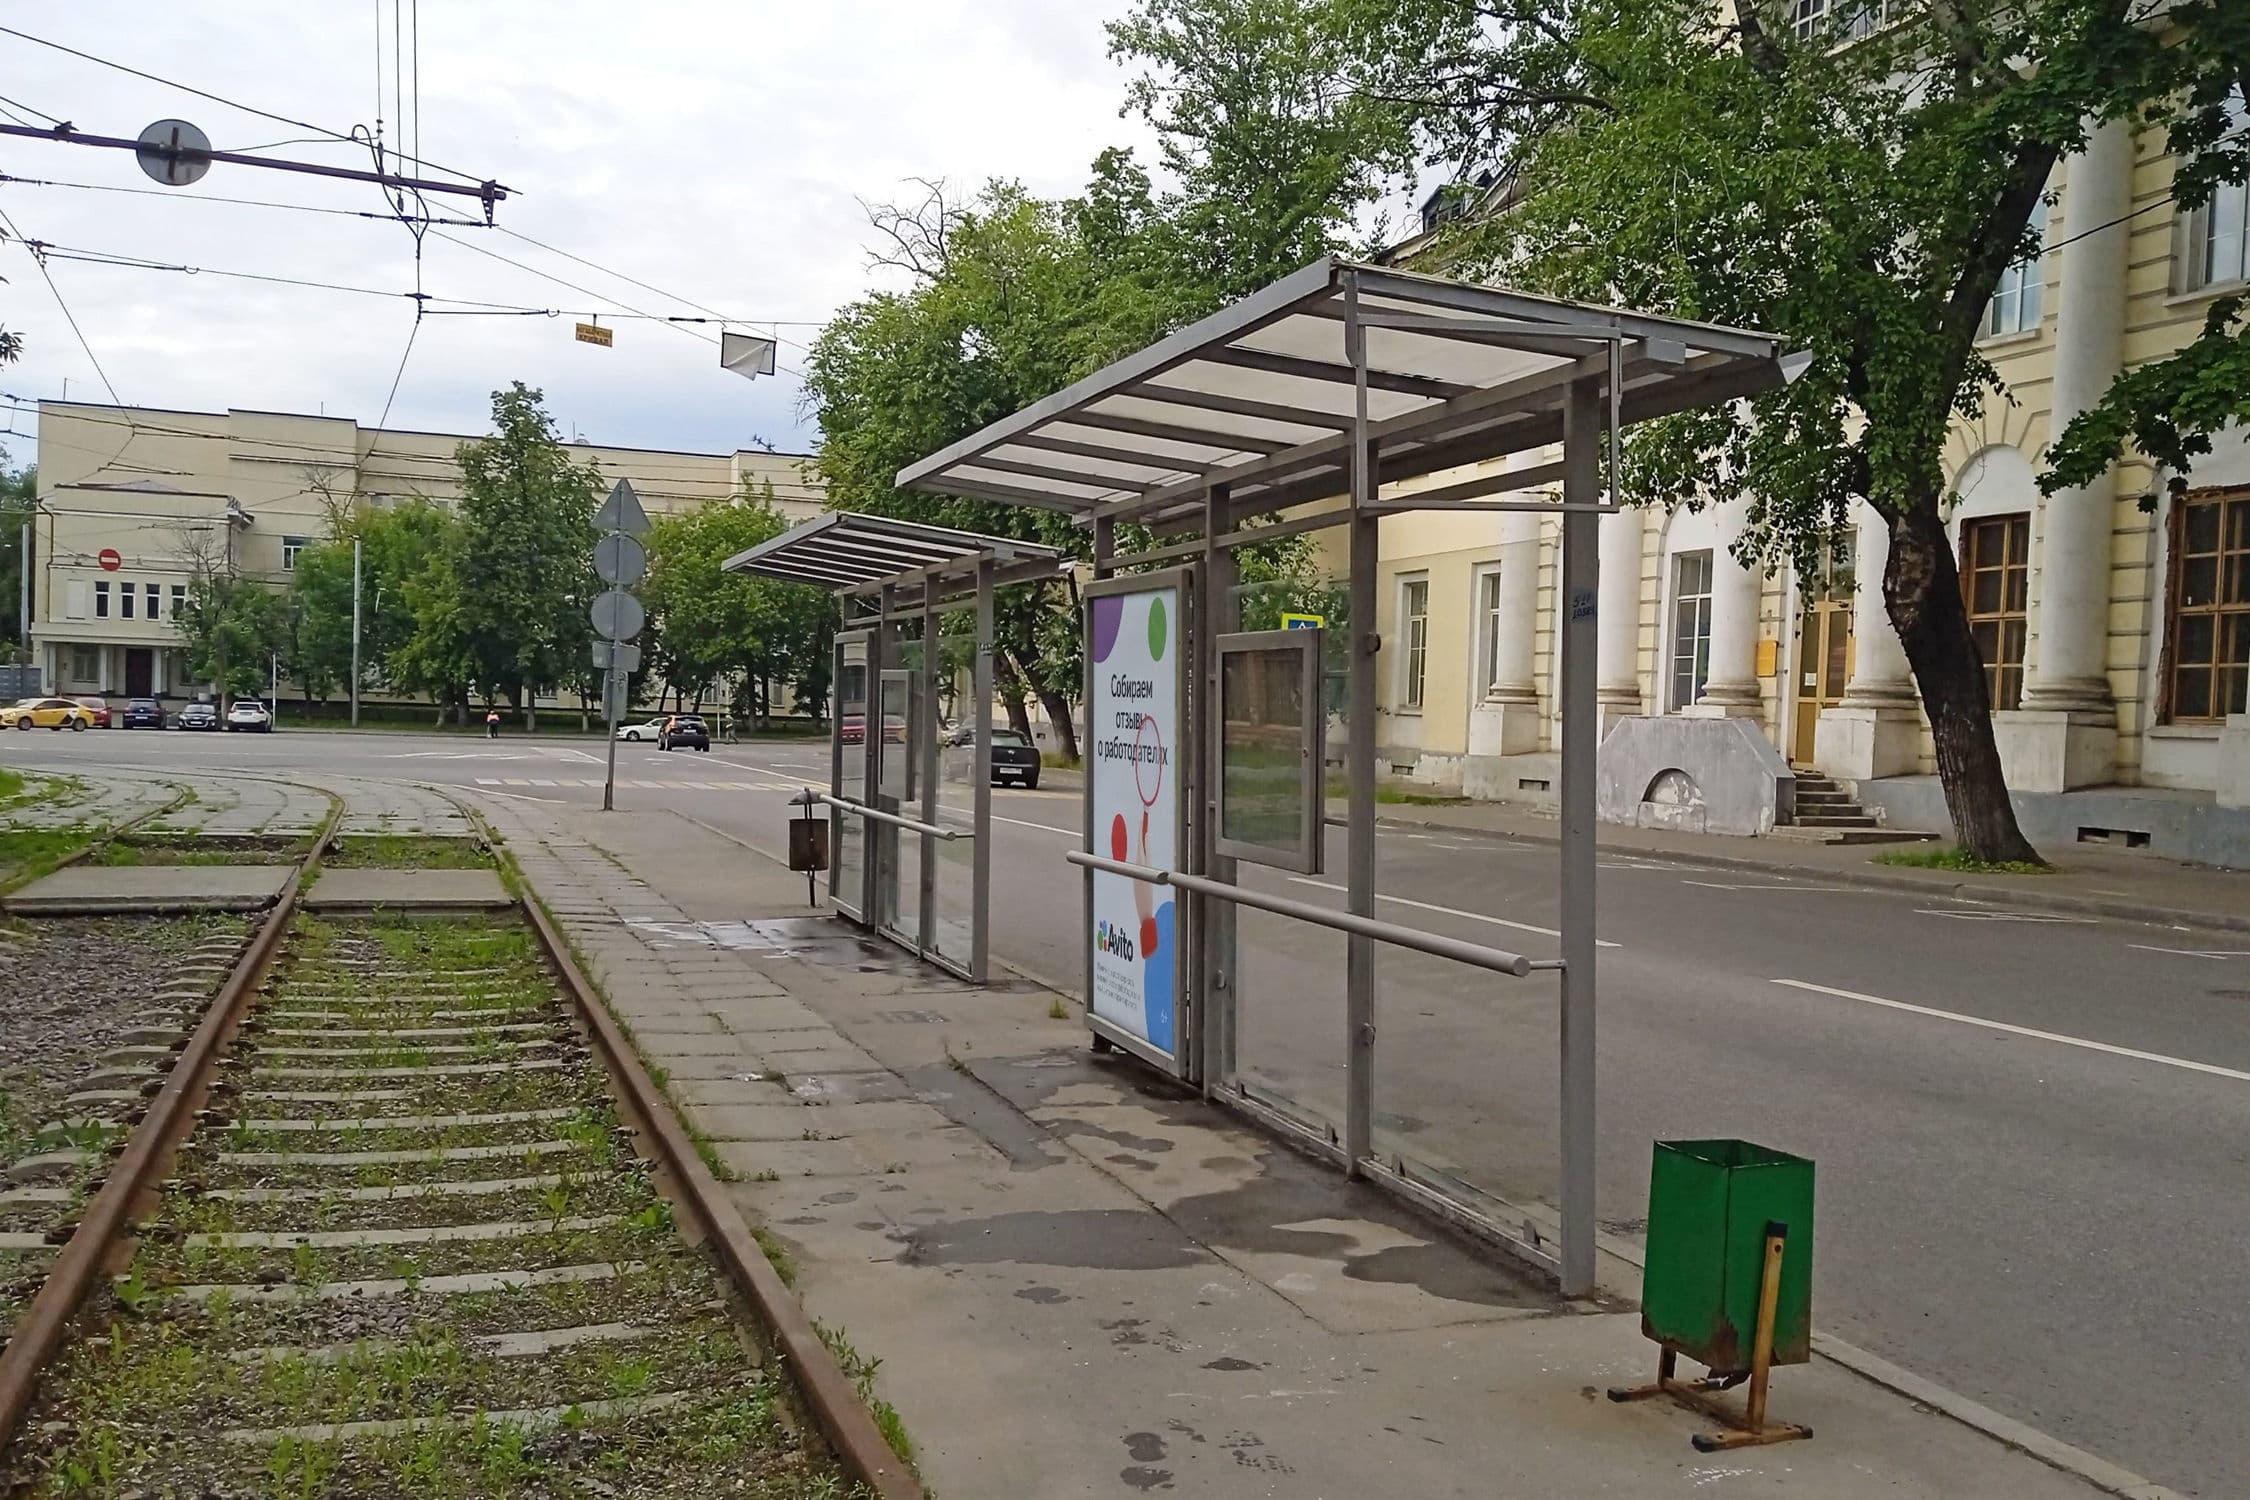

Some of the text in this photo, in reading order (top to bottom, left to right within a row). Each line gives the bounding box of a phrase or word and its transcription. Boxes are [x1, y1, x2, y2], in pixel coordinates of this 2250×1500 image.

[1111, 674, 1153, 703] Собираем
[1097, 740, 1103, 757] о
[1108, 923, 1134, 962] Avito
